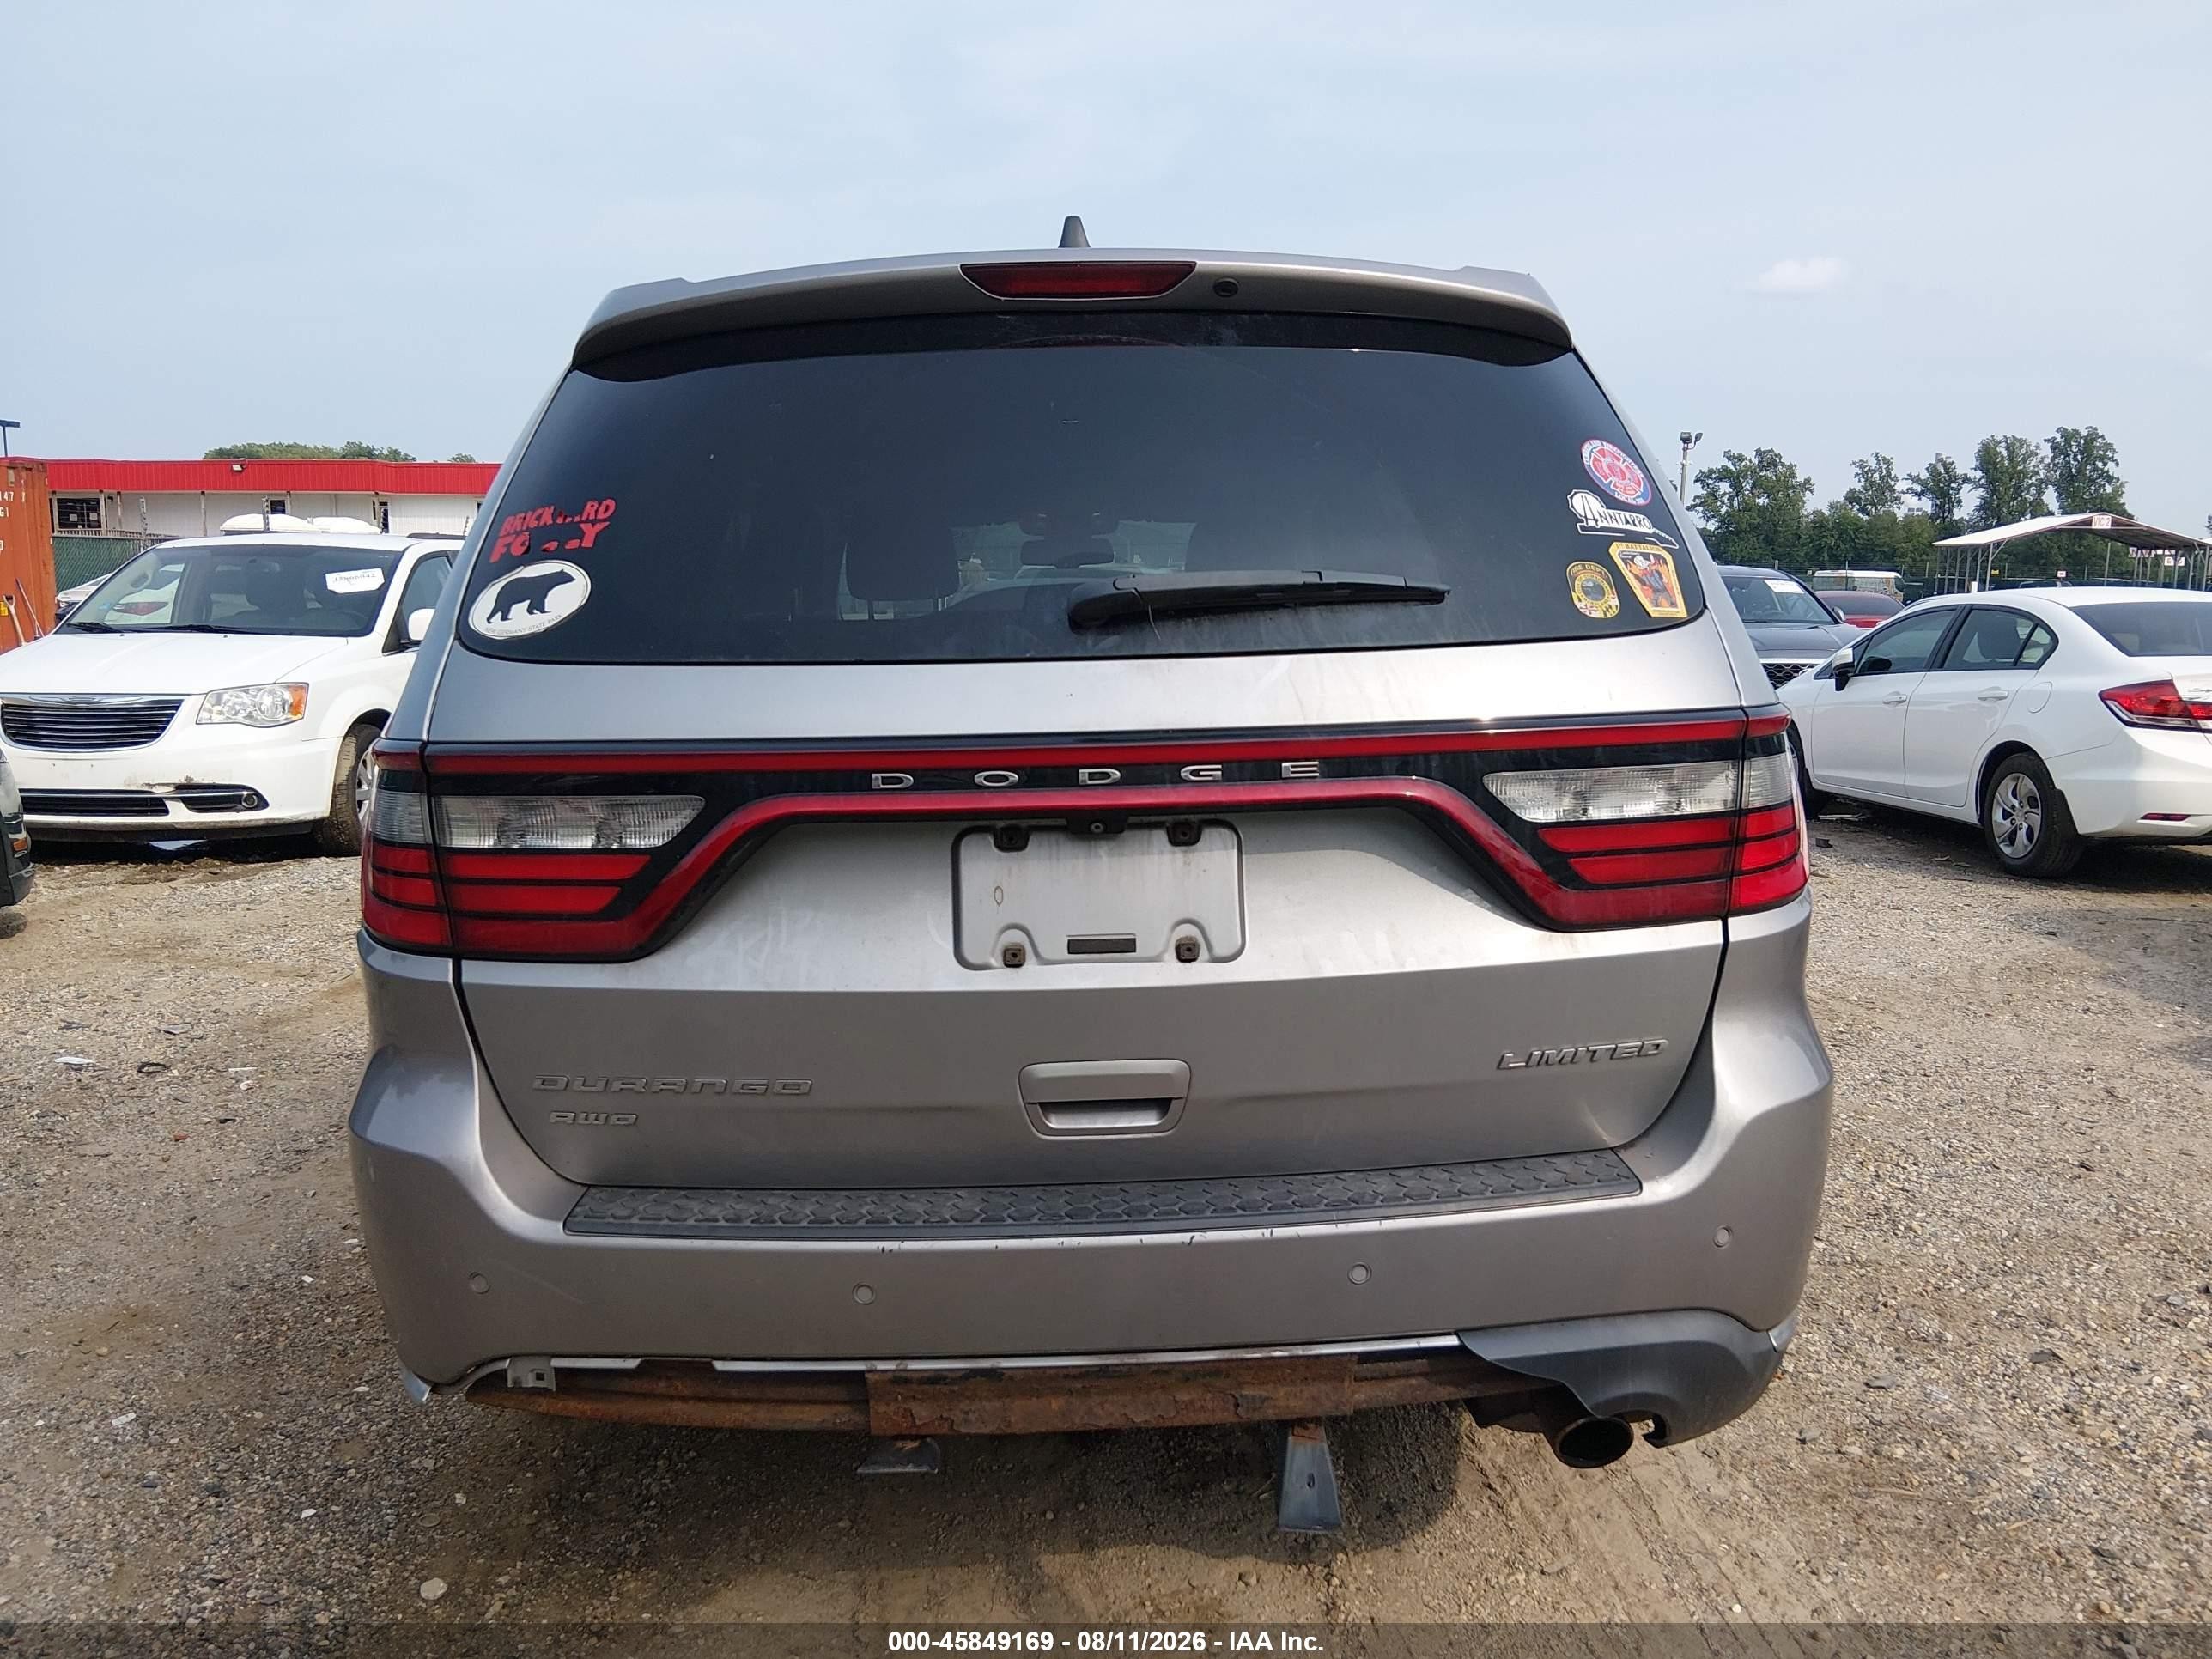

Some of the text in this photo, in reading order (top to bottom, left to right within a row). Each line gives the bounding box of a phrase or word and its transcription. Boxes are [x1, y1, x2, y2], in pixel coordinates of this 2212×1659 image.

[529, 623, 544, 631] STATE
[548, 615, 562, 624] PARK
[872, 761, 1320, 790] DODGE
[1497, 1037, 1668, 1070] LIMITED
[532, 1074, 814, 1095] DURANGO
[549, 1111, 638, 1126] AWD
